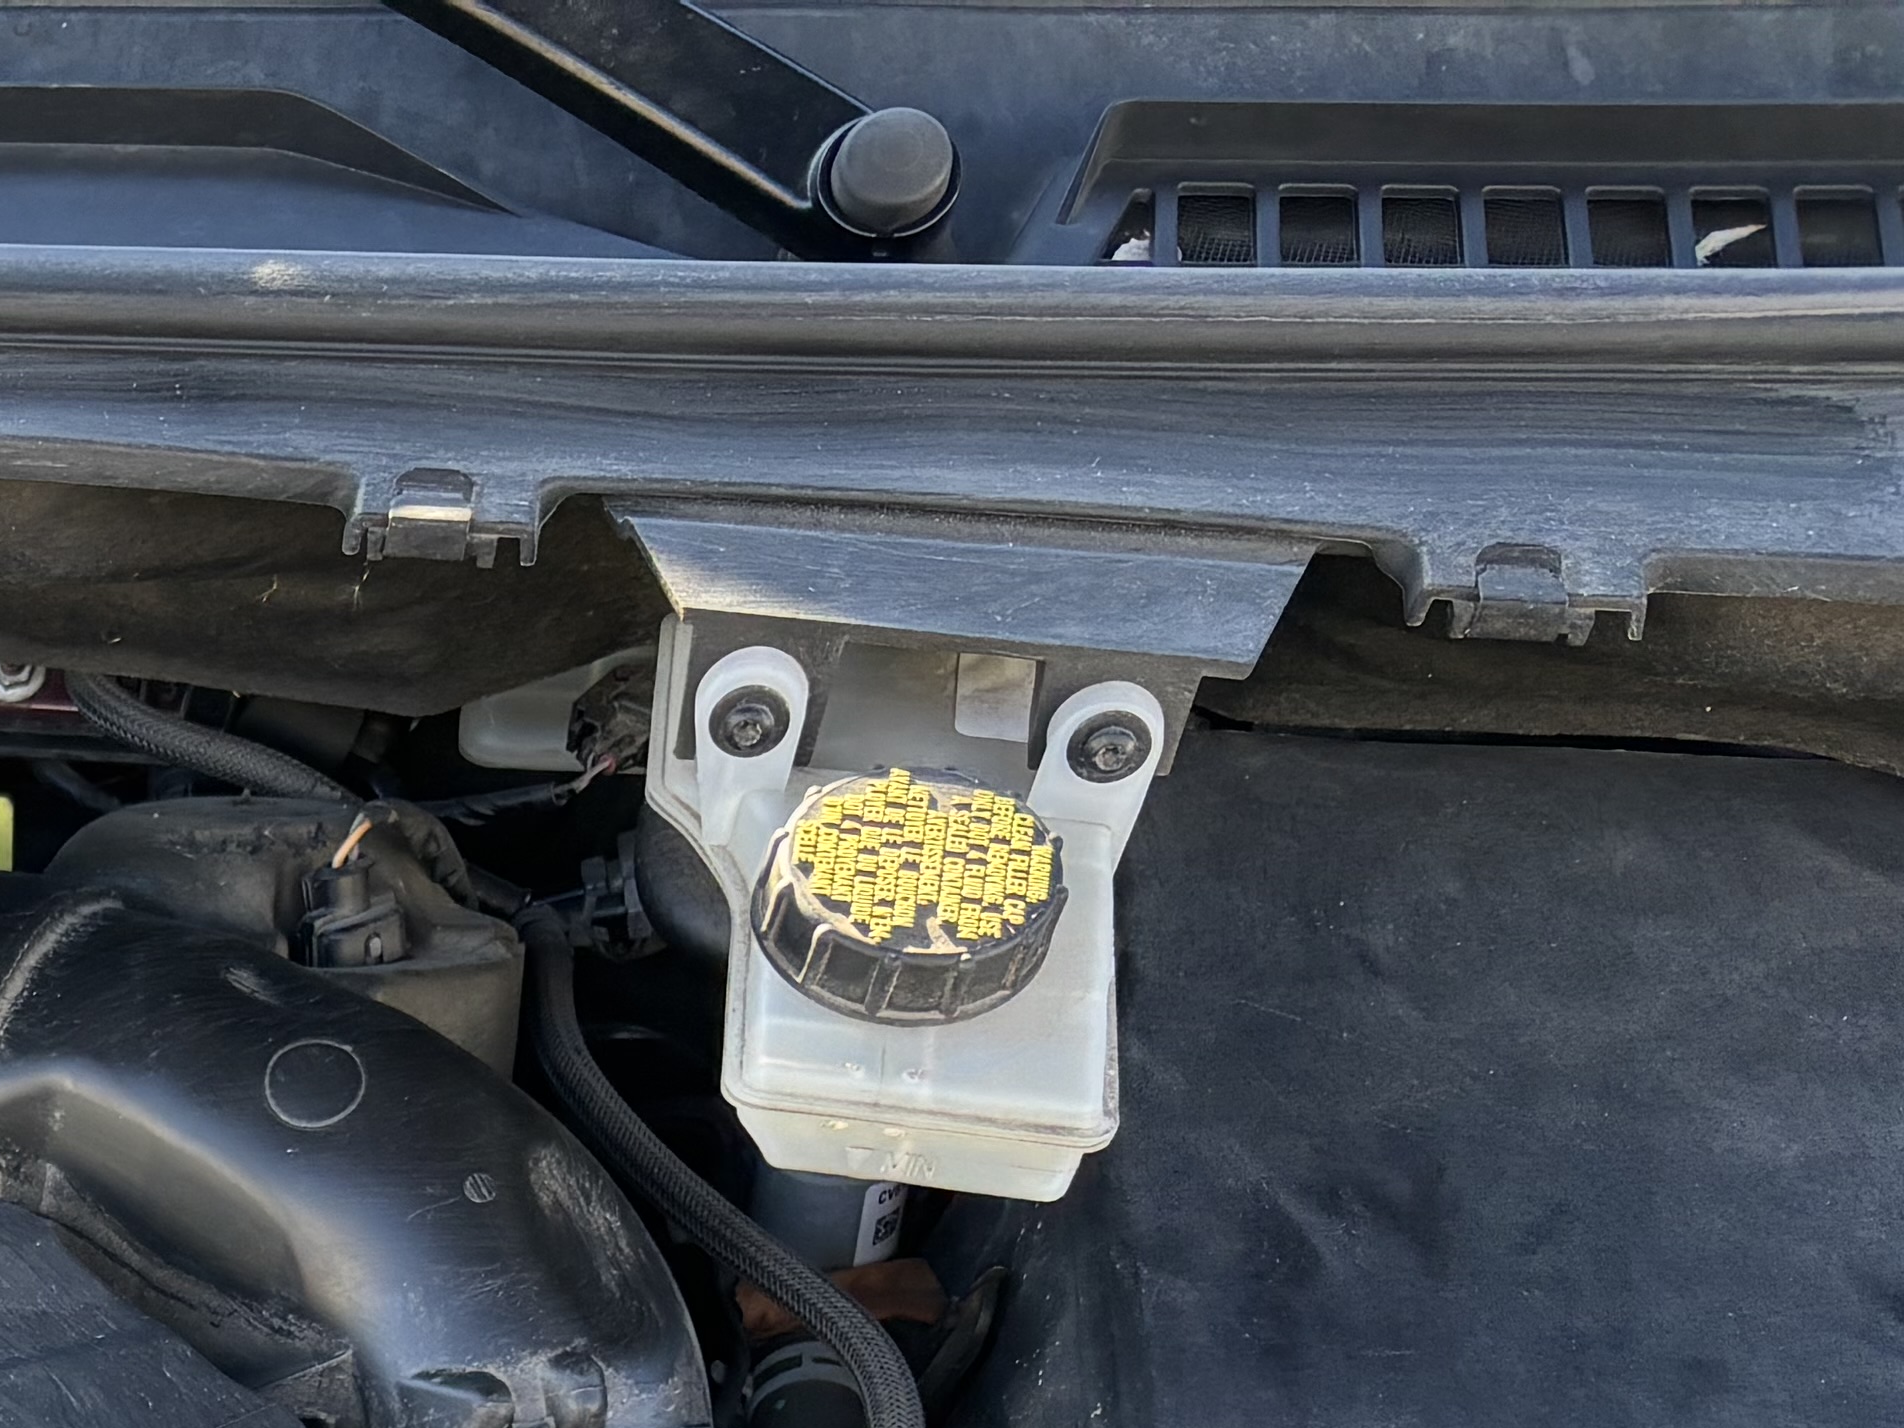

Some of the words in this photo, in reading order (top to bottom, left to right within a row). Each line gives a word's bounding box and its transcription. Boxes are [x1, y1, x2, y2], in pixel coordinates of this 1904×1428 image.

[886, 768, 910, 804] AVANT
[842, 794, 864, 816] DOT
[883, 807, 906, 824] DE
[971, 789, 994, 819] ONLY
[990, 796, 1015, 840] BEFORE
[858, 826, 882, 850] QUE
[881, 827, 904, 844] LE
[945, 809, 971, 853] SEALED
[968, 822, 991, 847] DOT
[1010, 813, 1034, 851] CLEAN
[856, 854, 878, 871] DU
[899, 847, 923, 864] LE
[960, 864, 986, 899] FLUID
[1005, 854, 1029, 895] FILLER
[848, 876, 874, 924] LIQUIDE
[891, 870, 920, 928] BOUCHON
[1002, 899, 1026, 925] CAP
[956, 902, 981, 940] FROM
[978, 912, 1003, 938] USE
[879, 1150, 938, 1178] MIN
